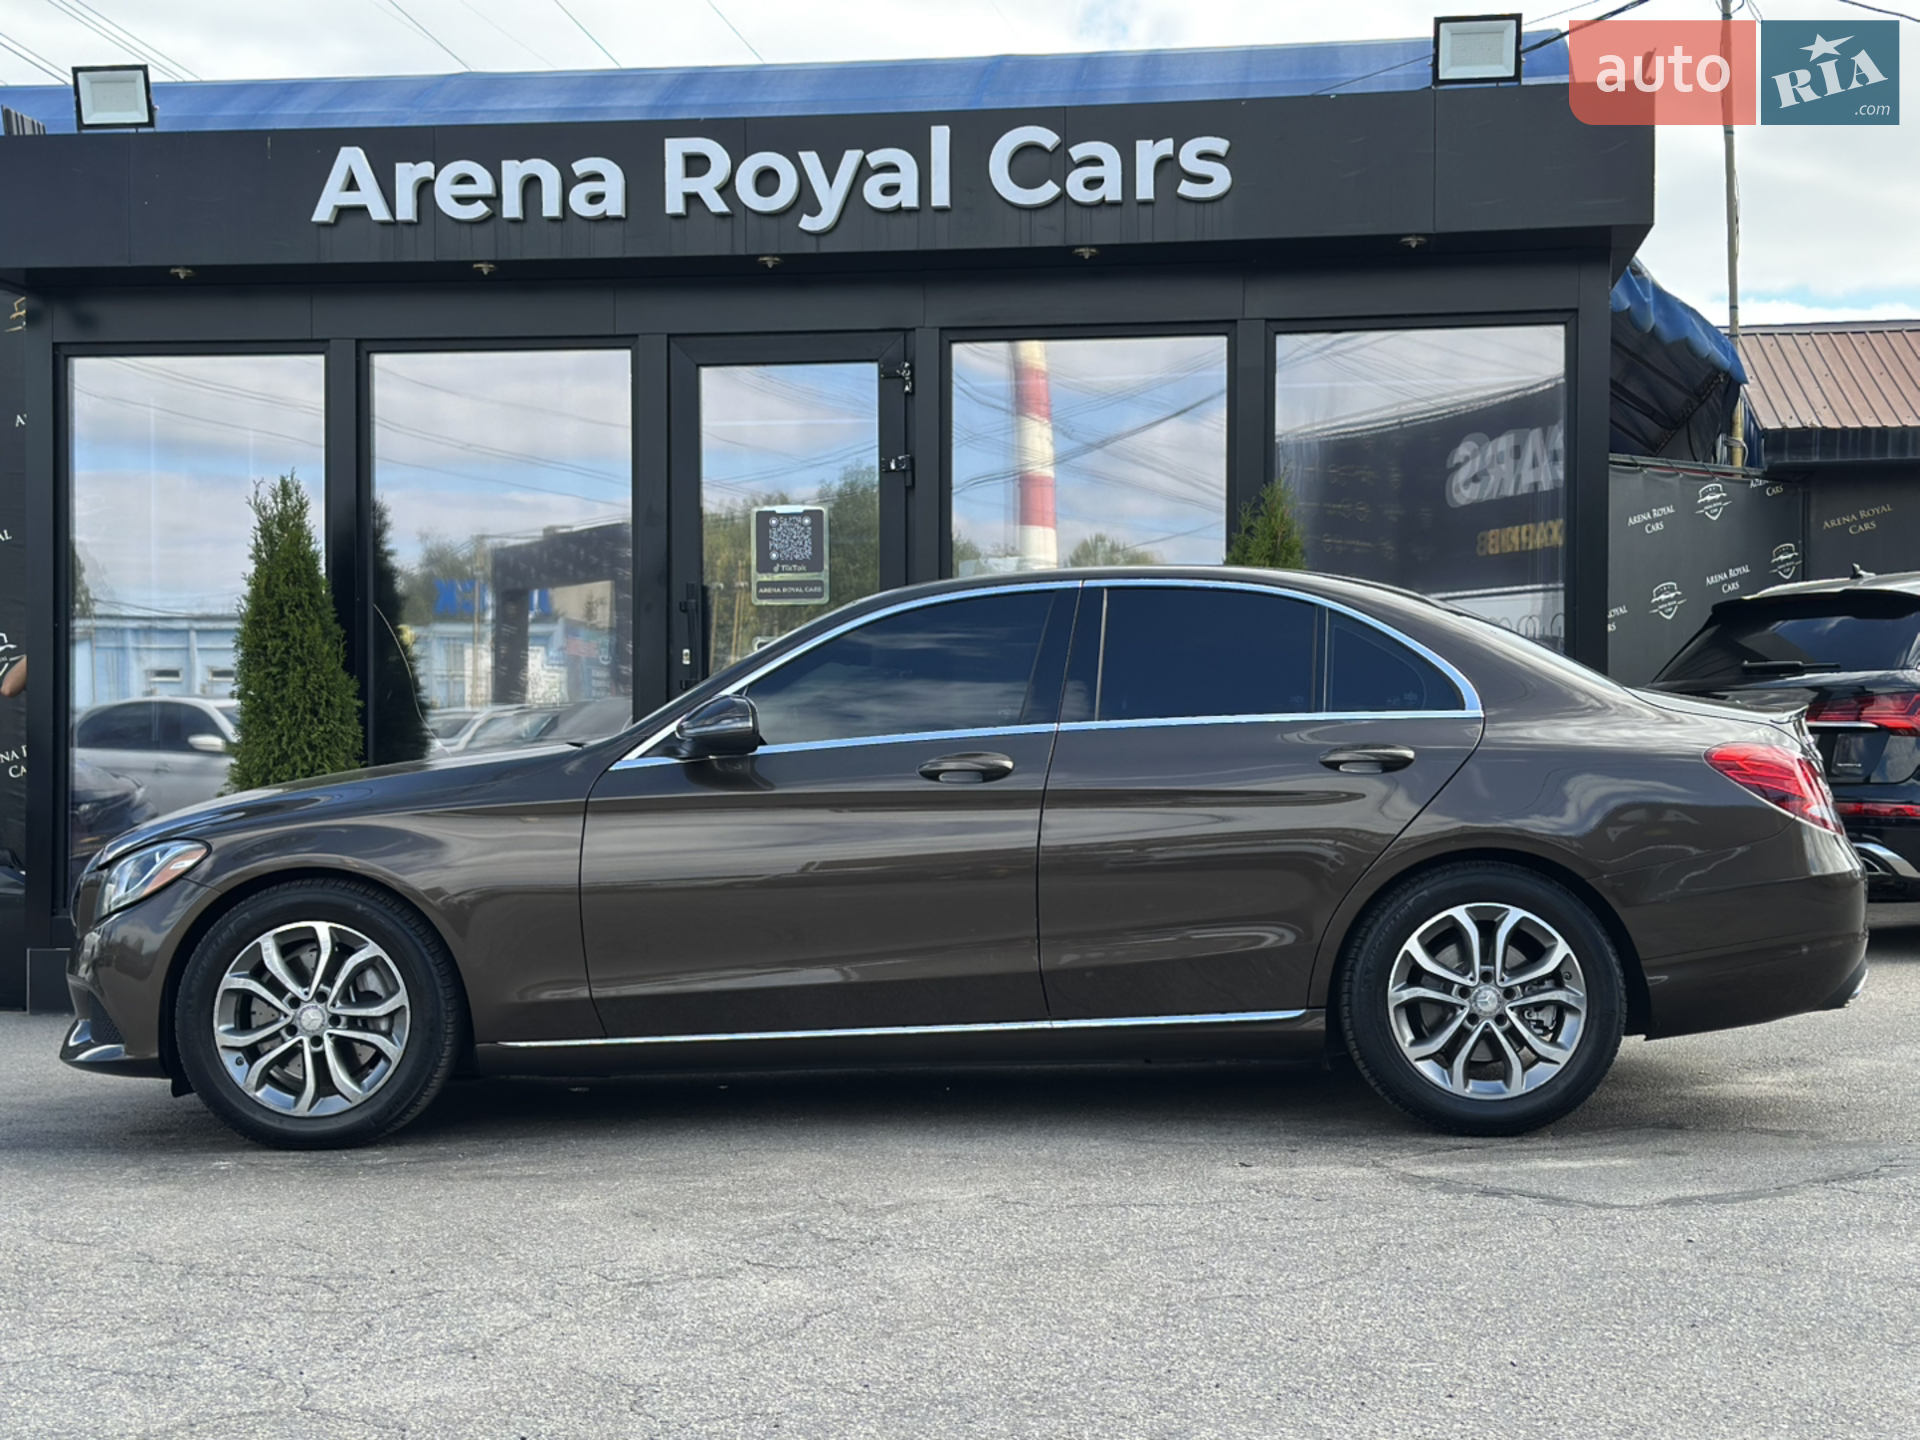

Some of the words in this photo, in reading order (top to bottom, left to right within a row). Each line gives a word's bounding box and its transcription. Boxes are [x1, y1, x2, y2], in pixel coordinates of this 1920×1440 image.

[311, 146, 627, 224] Arena
[664, 125, 951, 234] Royal
[987, 125, 1233, 206] Cars
[1628, 512, 1652, 527] ARENA
[1652, 504, 1675, 518] ROYAL
[1823, 514, 1858, 530] ARENA
[1859, 504, 1893, 519] ROYAL
[1645, 521, 1664, 534] CARS
[1848, 521, 1877, 535] CARS
[781, 564, 807, 572] TikTok
[1706, 572, 1729, 586] ARENA
[1729, 564, 1750, 578] ROYAL
[1722, 581, 1740, 593] CARS
